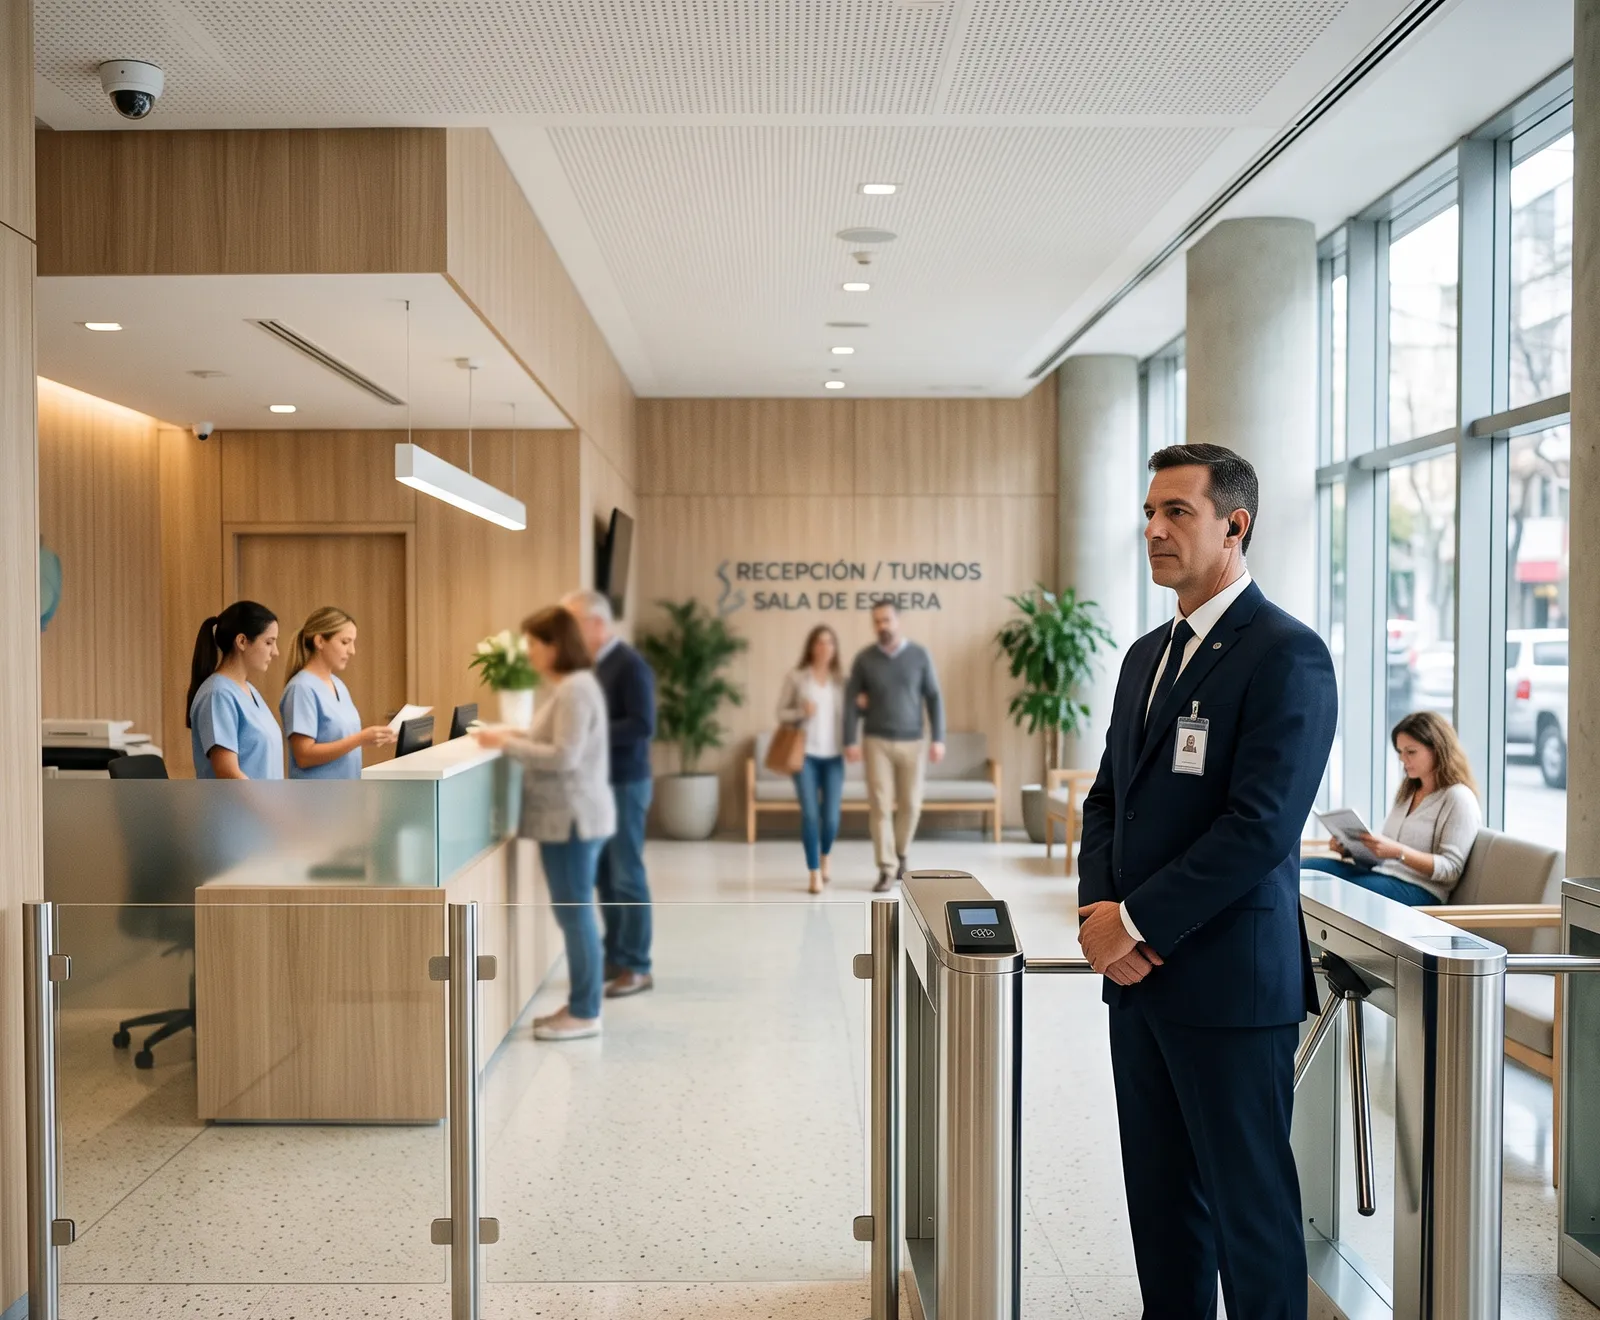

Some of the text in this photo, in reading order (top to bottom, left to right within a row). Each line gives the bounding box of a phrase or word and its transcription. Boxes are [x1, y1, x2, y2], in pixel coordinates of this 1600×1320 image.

[736, 559, 982, 581] RECEPCIÓN / TURNOS
[753, 592, 811, 611] SALA
[818, 592, 848, 610] DE
